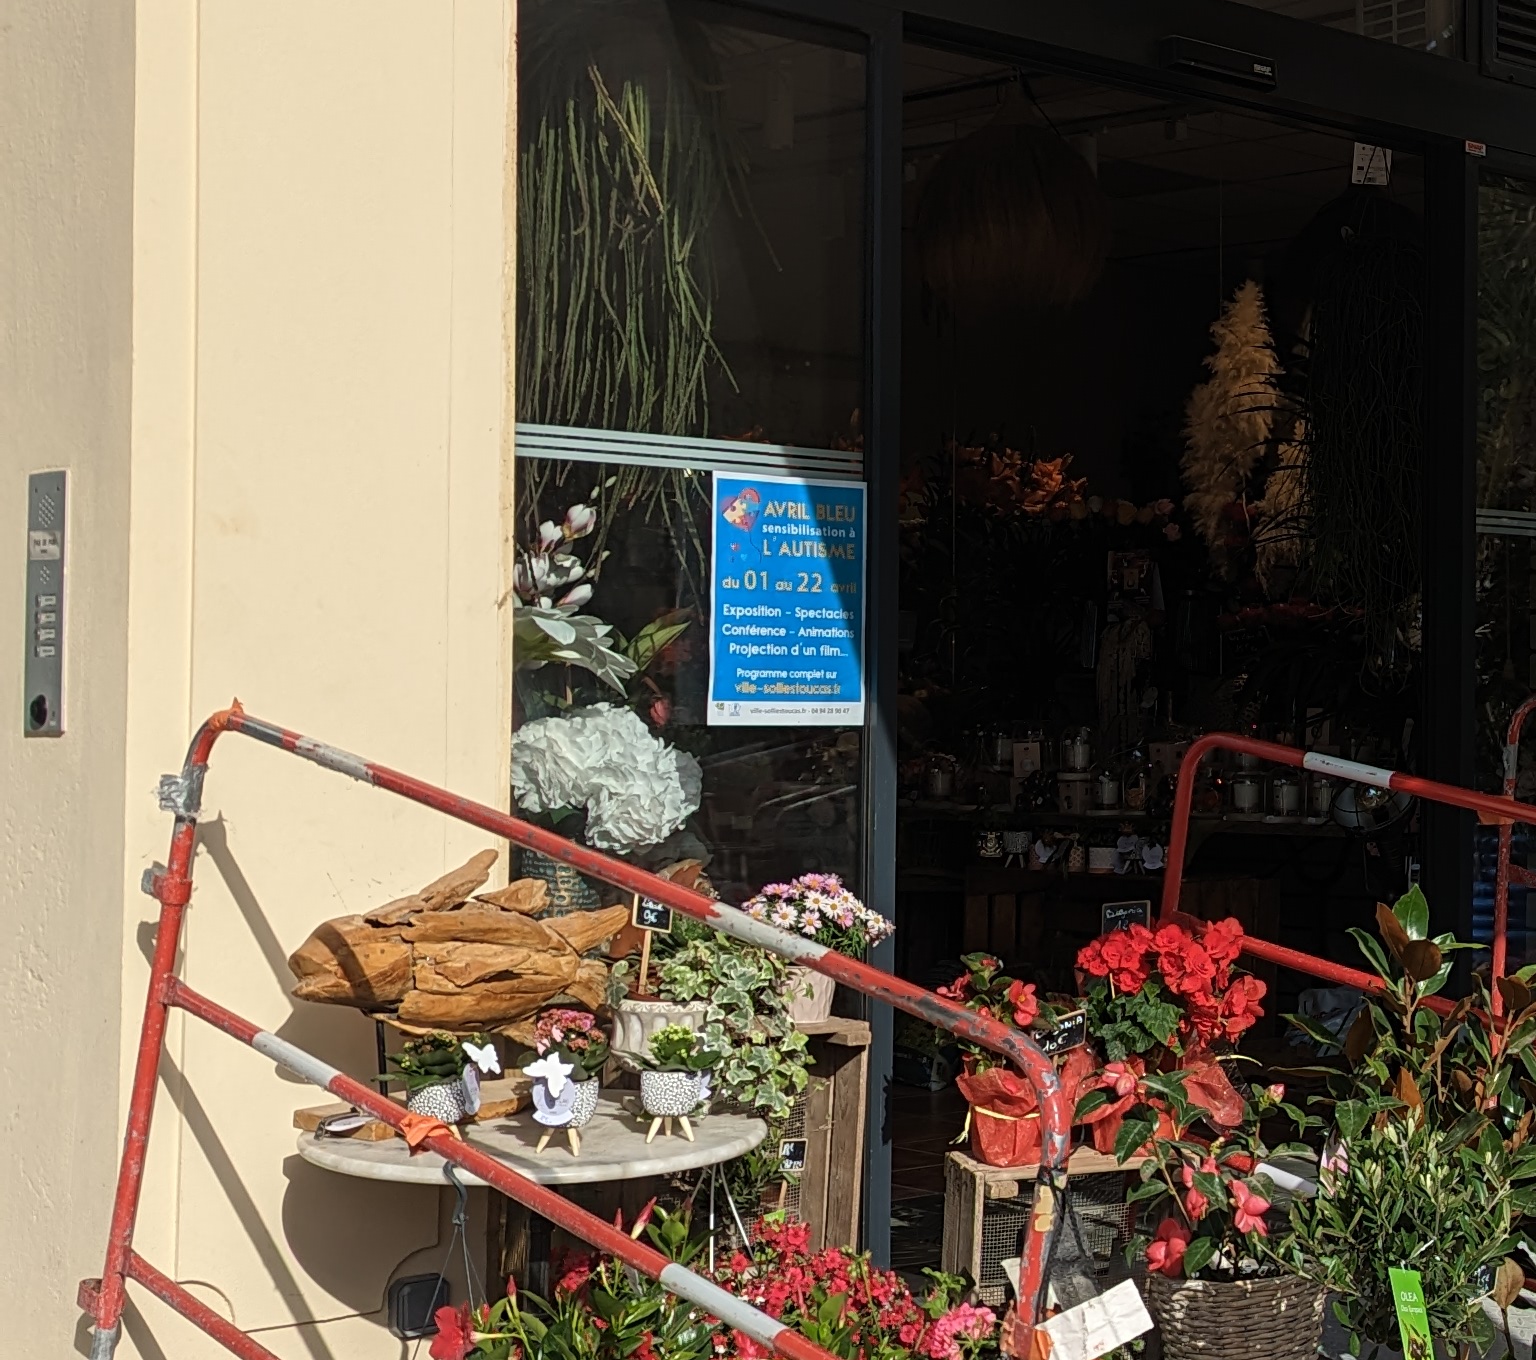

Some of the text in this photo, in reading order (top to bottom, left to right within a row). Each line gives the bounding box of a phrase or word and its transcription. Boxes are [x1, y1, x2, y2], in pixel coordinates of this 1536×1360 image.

[763, 499, 856, 522] AVRIL BLEU
[762, 523, 856, 538] sensibilisation à
[778, 539, 856, 560] AUTISME
[721, 569, 856, 594] du 01 au 22 avril
[722, 603, 782, 619] Exposition
[794, 606, 855, 621] Spectacles
[721, 623, 787, 637] Conférence
[797, 626, 855, 639] Animations
[729, 642, 788, 658] Projection
[790, 642, 817, 656] d'un
[736, 667, 838, 682] Programme complet sur
[1400, 1290, 1419, 1303] OLEA
